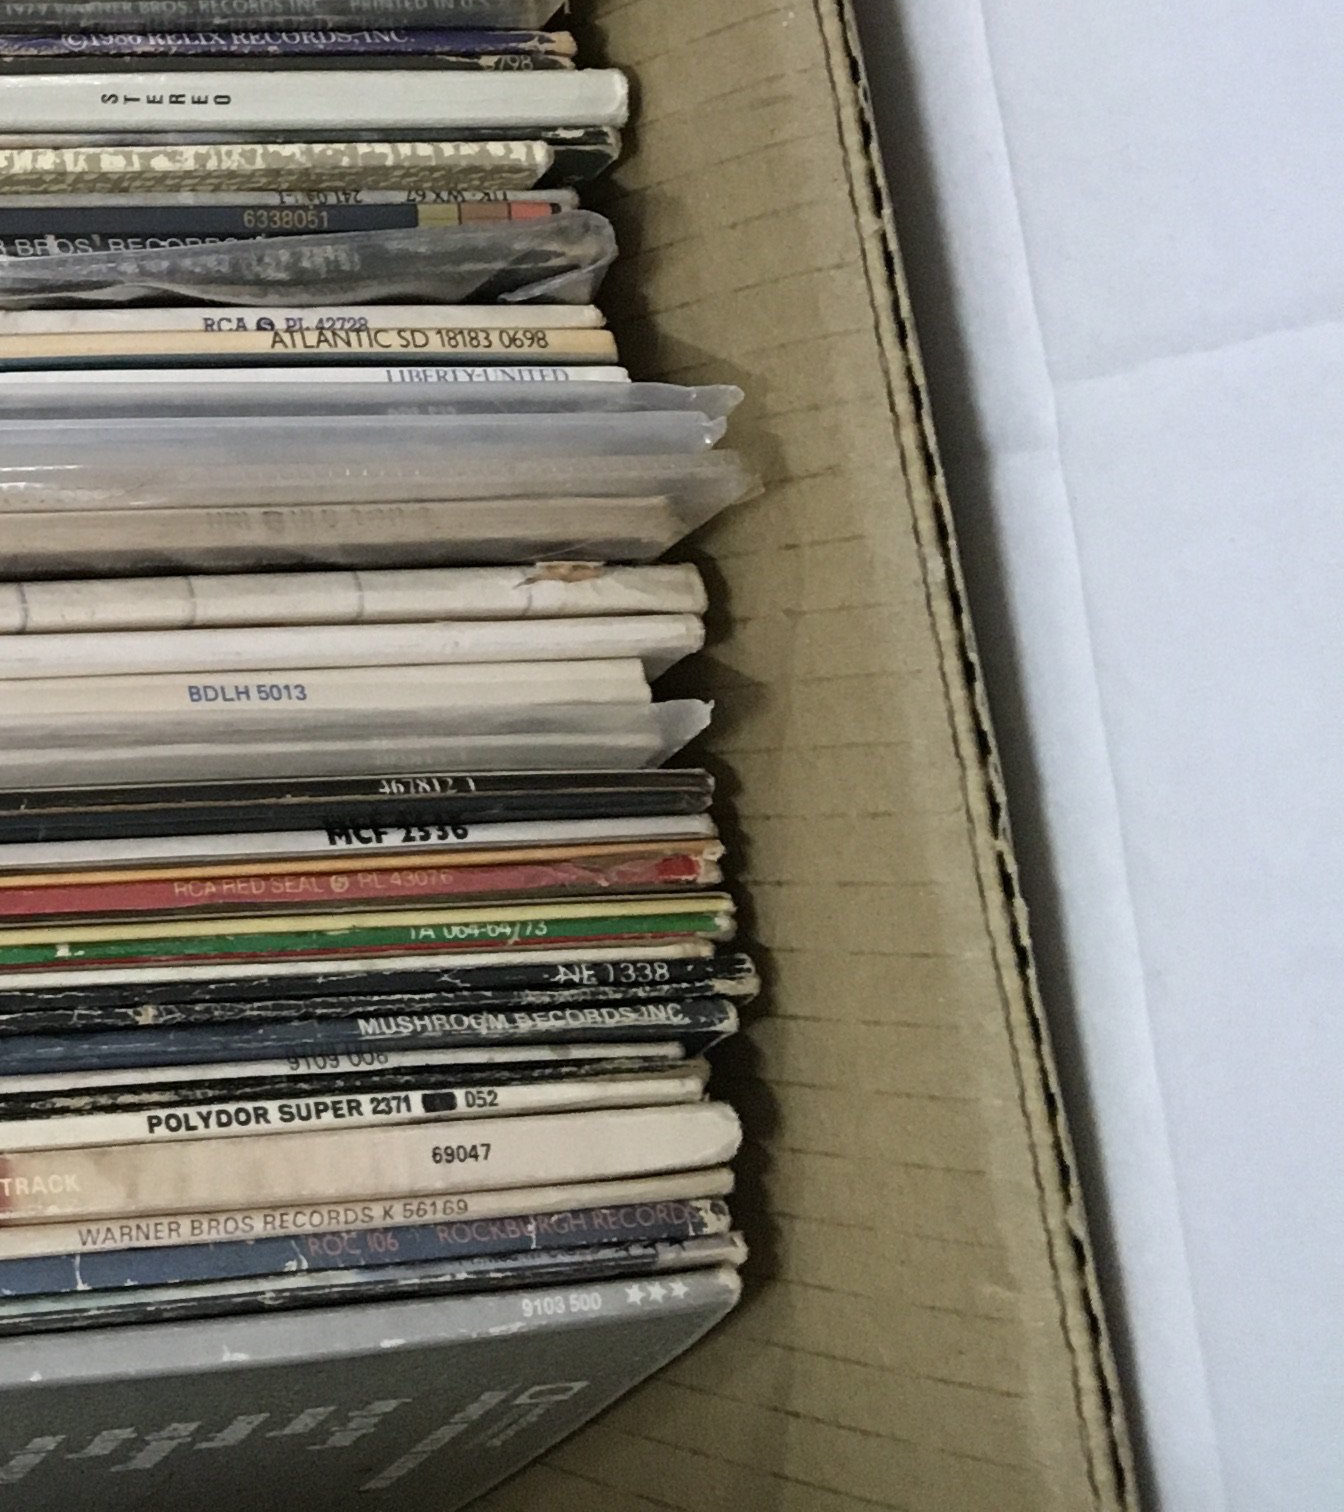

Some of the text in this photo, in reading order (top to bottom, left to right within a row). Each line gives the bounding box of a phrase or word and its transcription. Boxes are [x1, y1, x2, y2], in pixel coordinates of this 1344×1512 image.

[270, 329, 548, 348] ATLANTIC SD 18183 0698
[188, 684, 306, 702] BDLH 5013
[147, 1089, 498, 1133] POLYDOR SUPER 2371 052
[431, 1143, 492, 1165] 69047
[78, 1199, 468, 1247] WARNER BROS RECORDS K 56169
[521, 1293, 601, 1317] 9103 500
